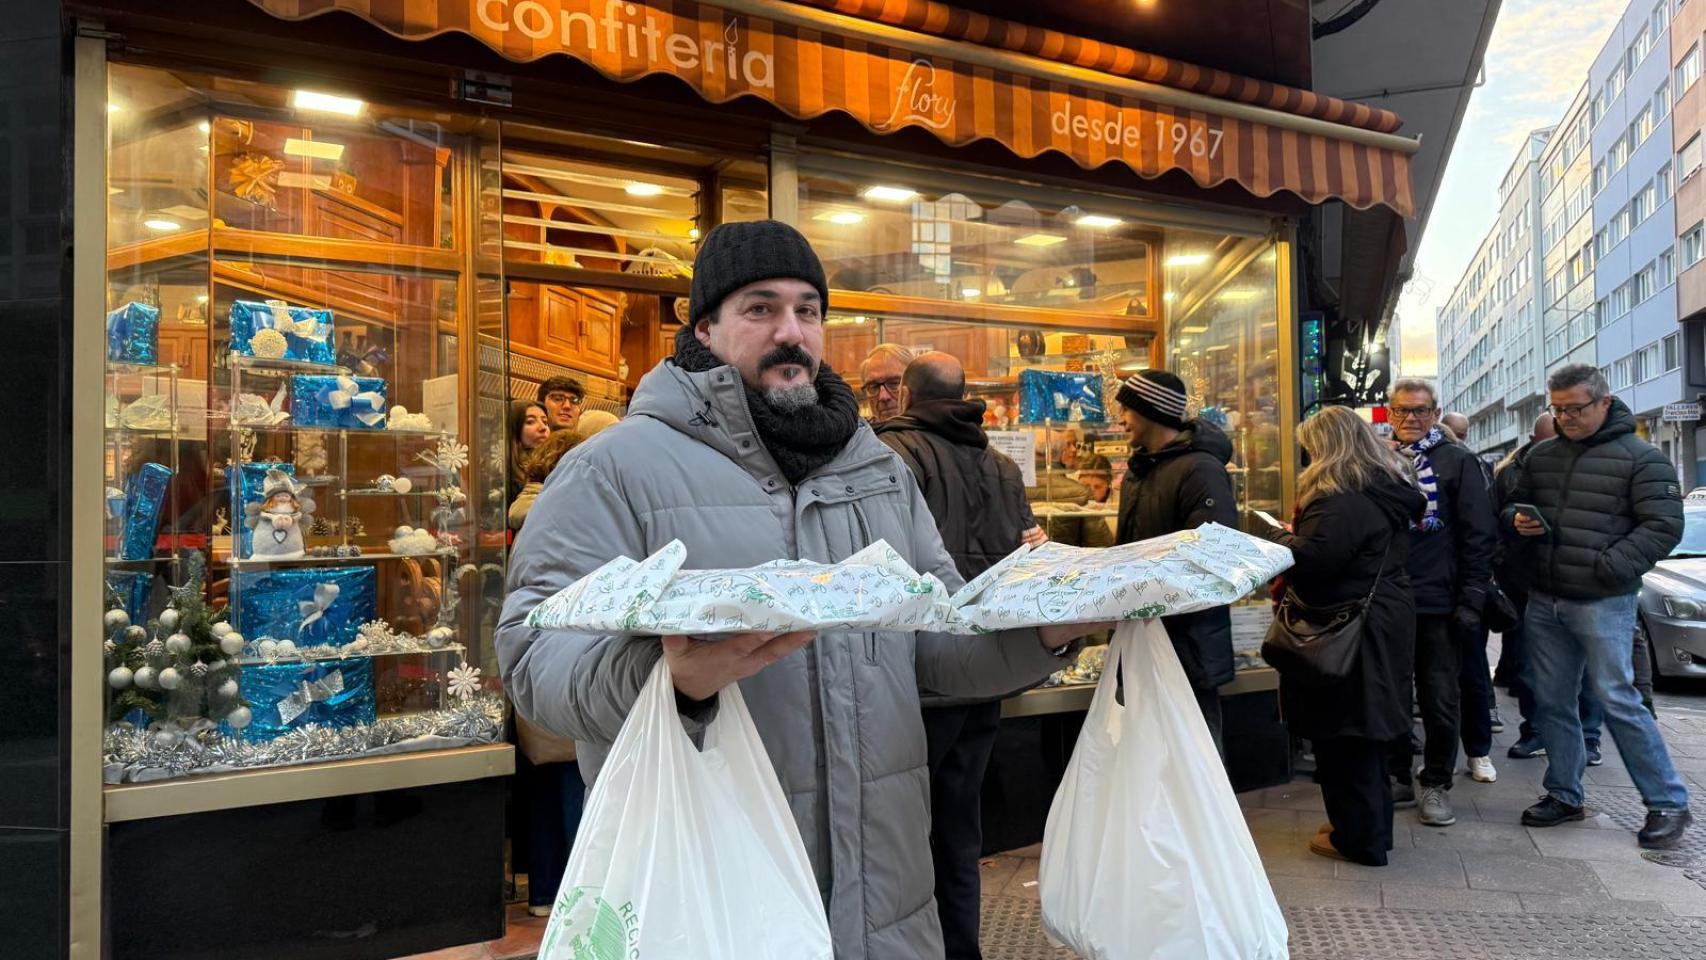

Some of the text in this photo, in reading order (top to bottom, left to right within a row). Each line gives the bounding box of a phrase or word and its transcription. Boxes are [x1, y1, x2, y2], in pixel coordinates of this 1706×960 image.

[476, 0, 775, 88] confiteria
[1051, 101, 1224, 160] desde 1967
[619, 900, 640, 960] RECIC
